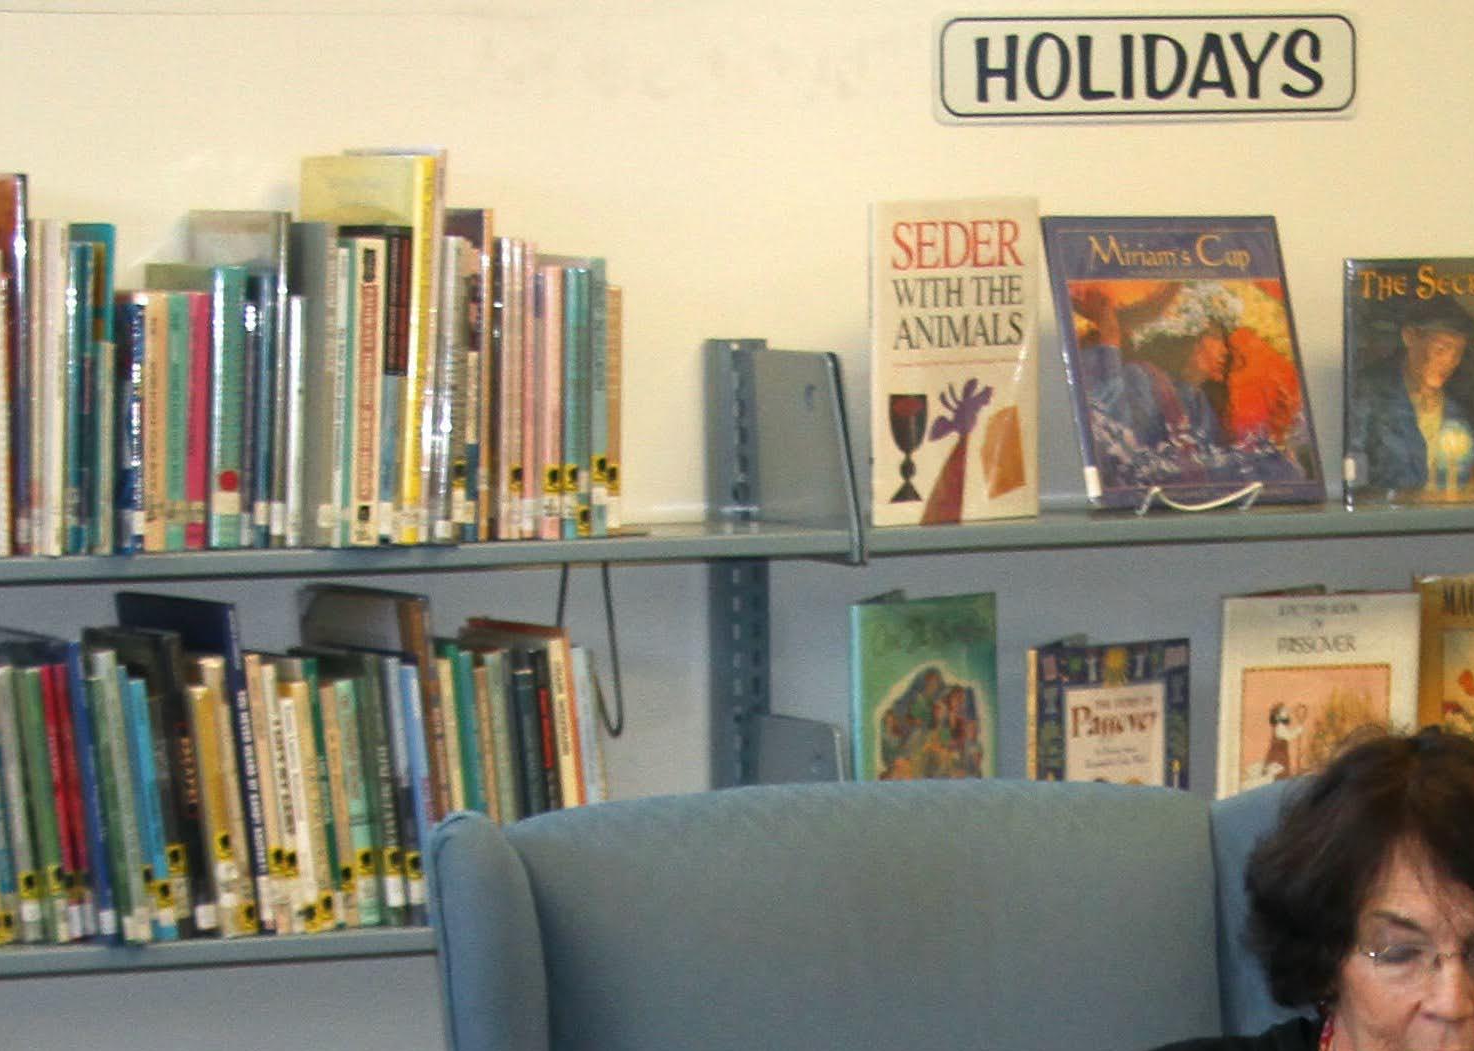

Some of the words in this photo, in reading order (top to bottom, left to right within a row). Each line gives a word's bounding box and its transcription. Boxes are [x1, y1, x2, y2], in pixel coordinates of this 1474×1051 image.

[974, 28, 1325, 102] HOLIDAYS
[891, 218, 1025, 271] SEDER
[1088, 234, 1192, 271] Miriam's
[1194, 233, 1252, 270] Cup
[893, 276, 968, 309] WITH
[973, 274, 1023, 307] THE
[893, 312, 1024, 351] ANIMALS
